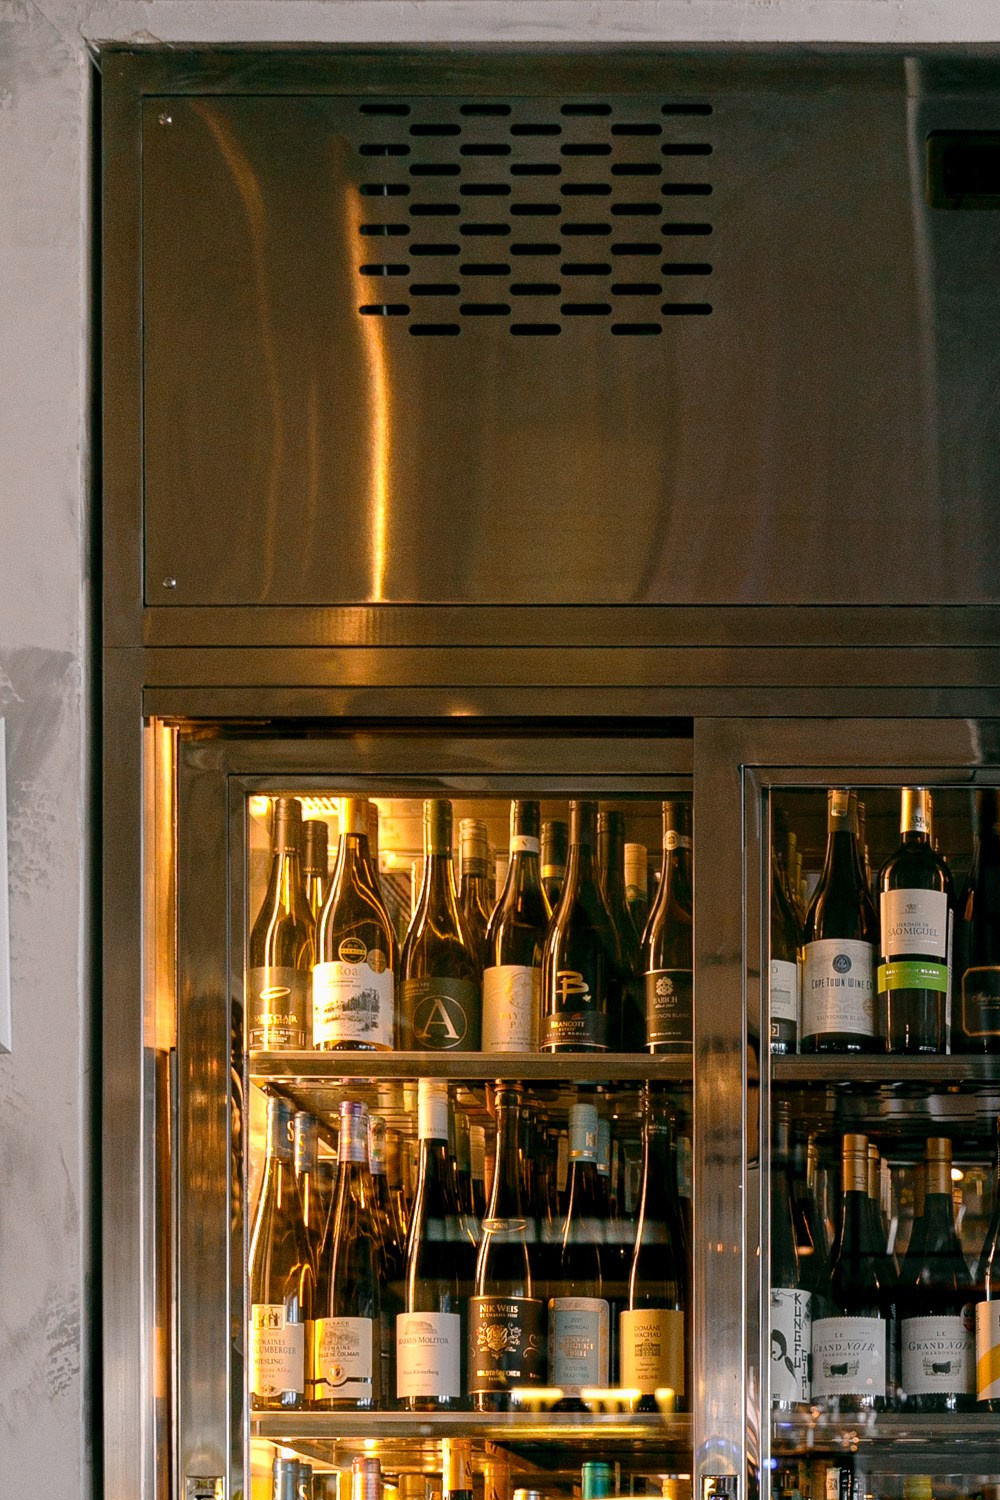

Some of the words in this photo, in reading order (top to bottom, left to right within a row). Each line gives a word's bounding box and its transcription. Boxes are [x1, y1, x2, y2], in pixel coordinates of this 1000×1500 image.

[903, 927, 939, 937] MIGUEL
[555, 970, 590, 1005] B
[811, 979, 825, 990] CAPE
[826, 977, 845, 988] TOWN
[847, 977, 865, 989] WINE
[415, 998, 461, 1039] A
[550, 1021, 586, 1029] BRANCOTT
[479, 1304, 495, 1313] NIK
[497, 1303, 519, 1313] WEIS
[793, 1292, 802, 1369] KUNGFU
[418, 1336, 449, 1344] MOLITOR
[813, 1344, 842, 1354] GRAND
[843, 1341, 876, 1352] NOIR
[908, 1341, 945, 1352] GRAND
